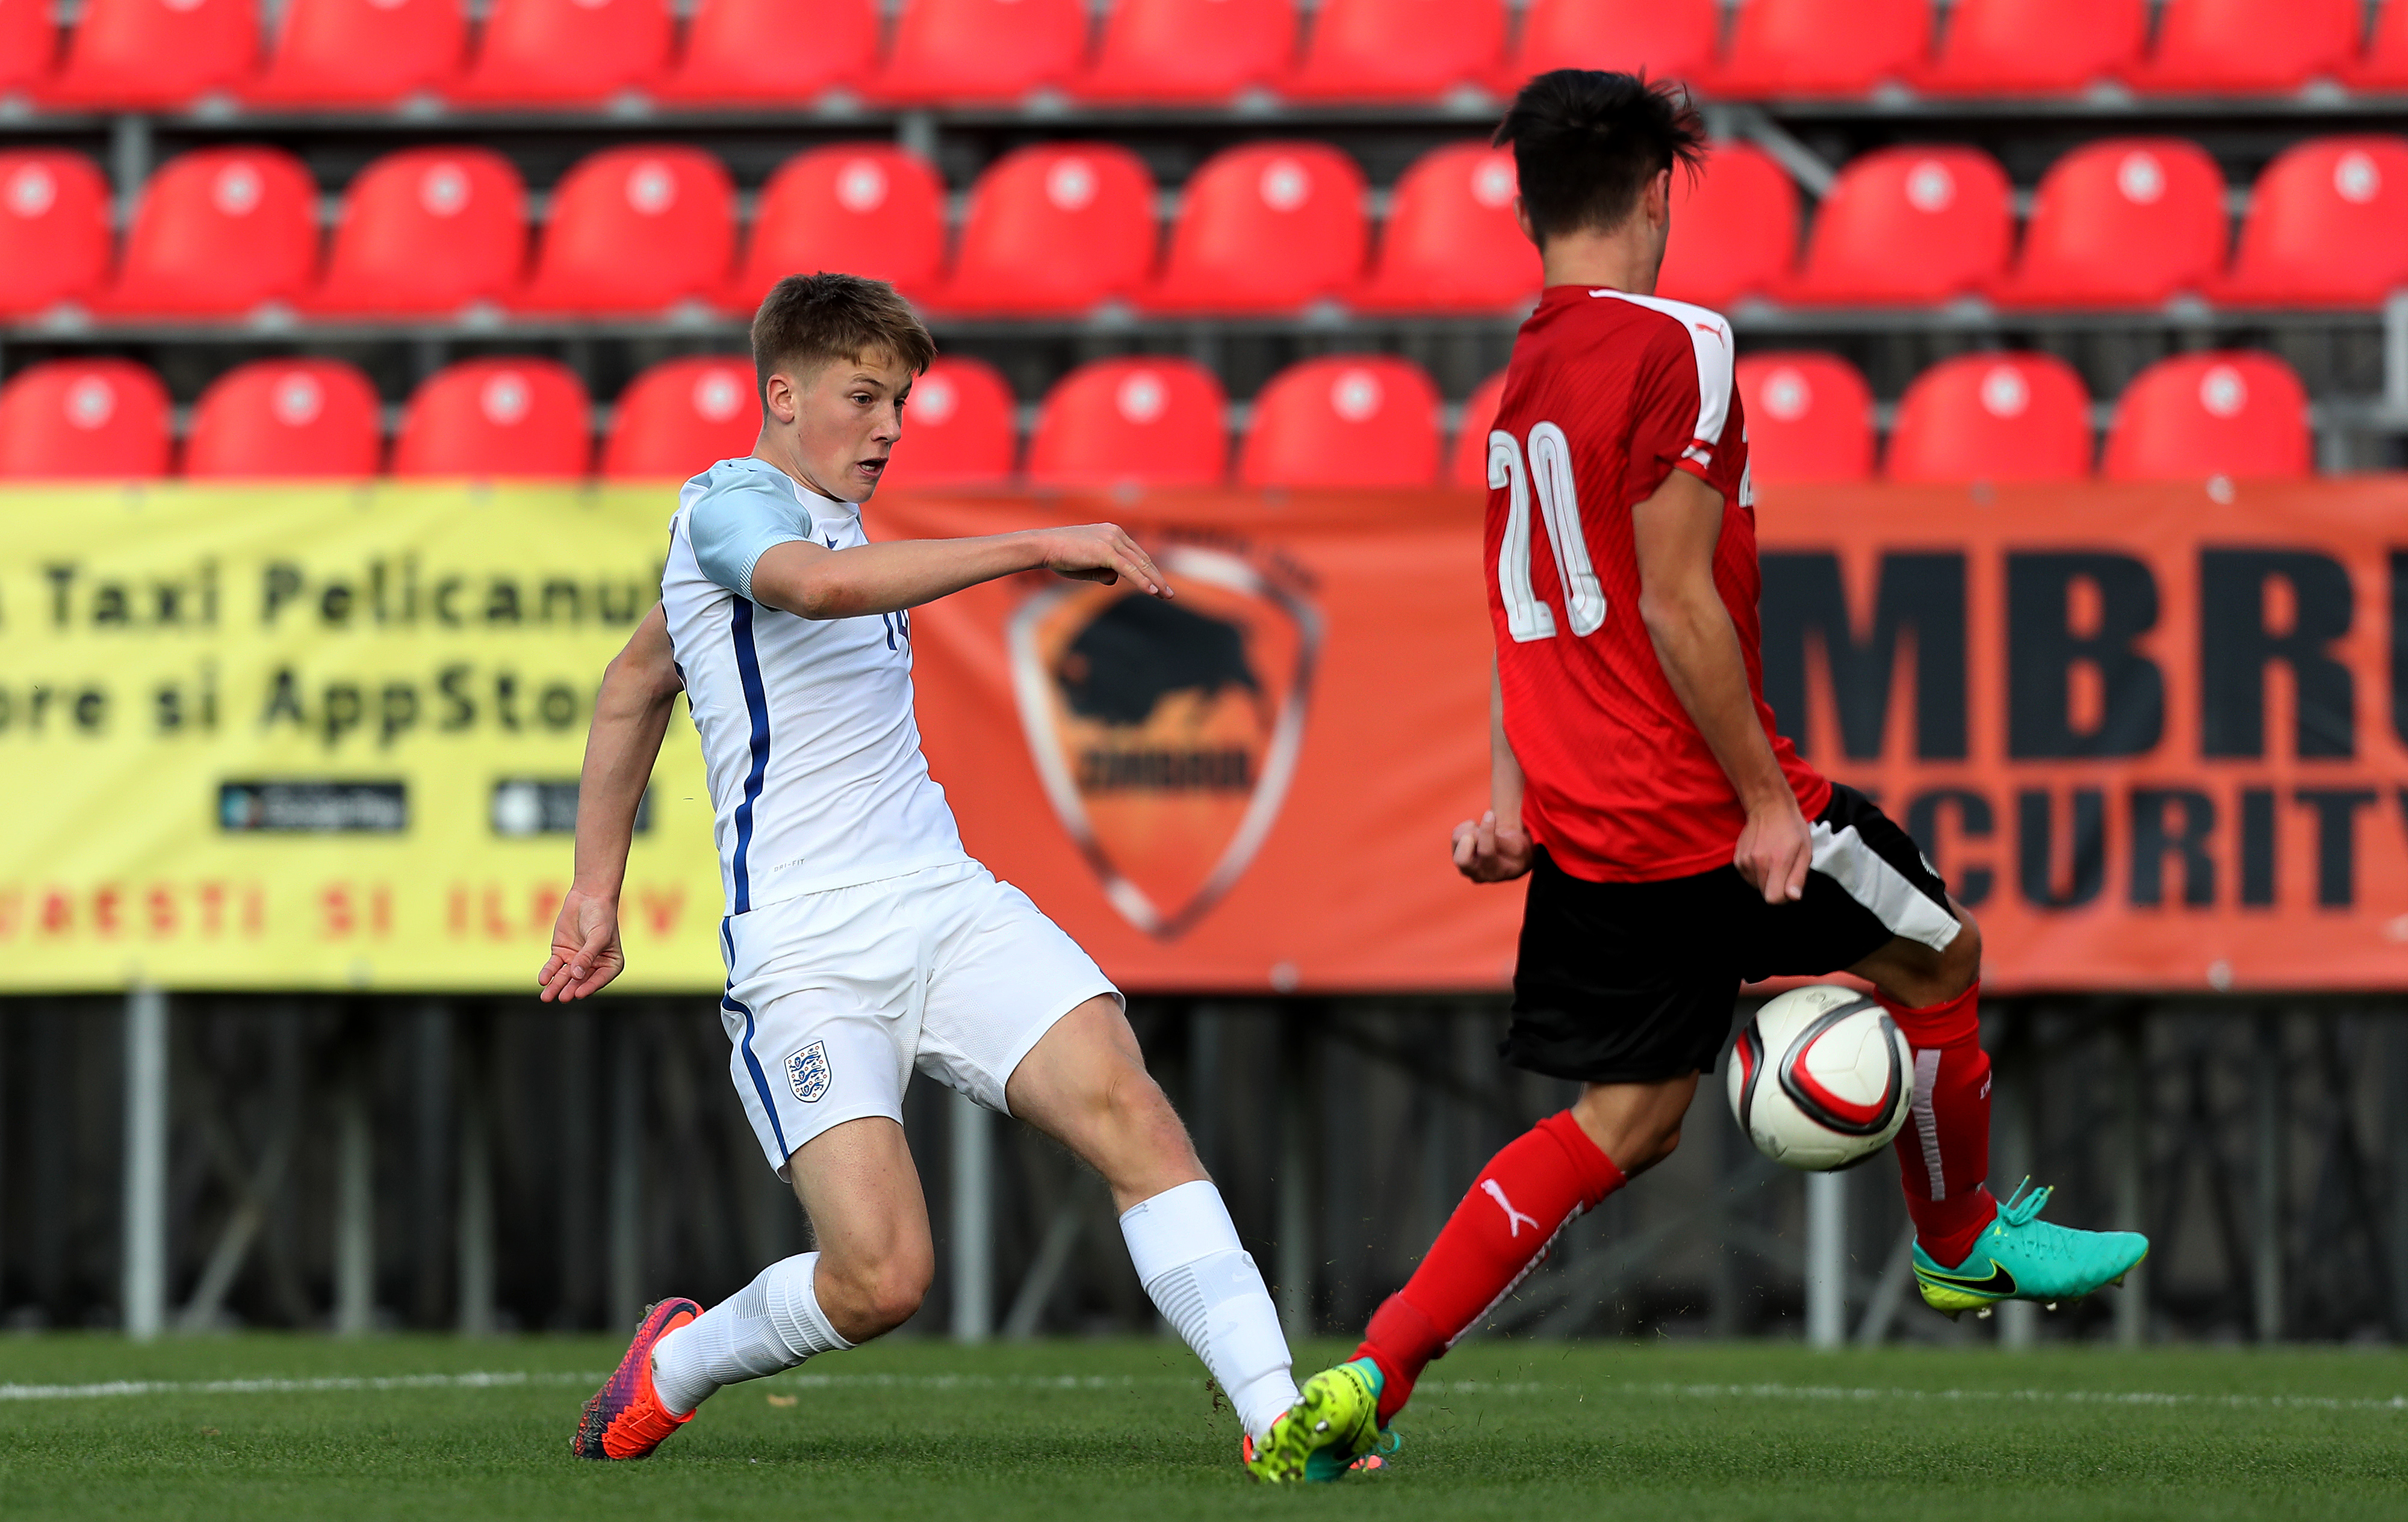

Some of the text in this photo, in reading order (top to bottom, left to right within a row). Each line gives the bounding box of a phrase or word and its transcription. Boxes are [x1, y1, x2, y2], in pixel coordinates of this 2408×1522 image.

[1487, 421, 1607, 643] 20
[43, 555, 220, 627] Taxi
[158, 663, 218, 729] si
[1759, 549, 2408, 761] MBR
[774, 858, 805, 873] DRI-FIT
[1864, 785, 2408, 910] CURIT
